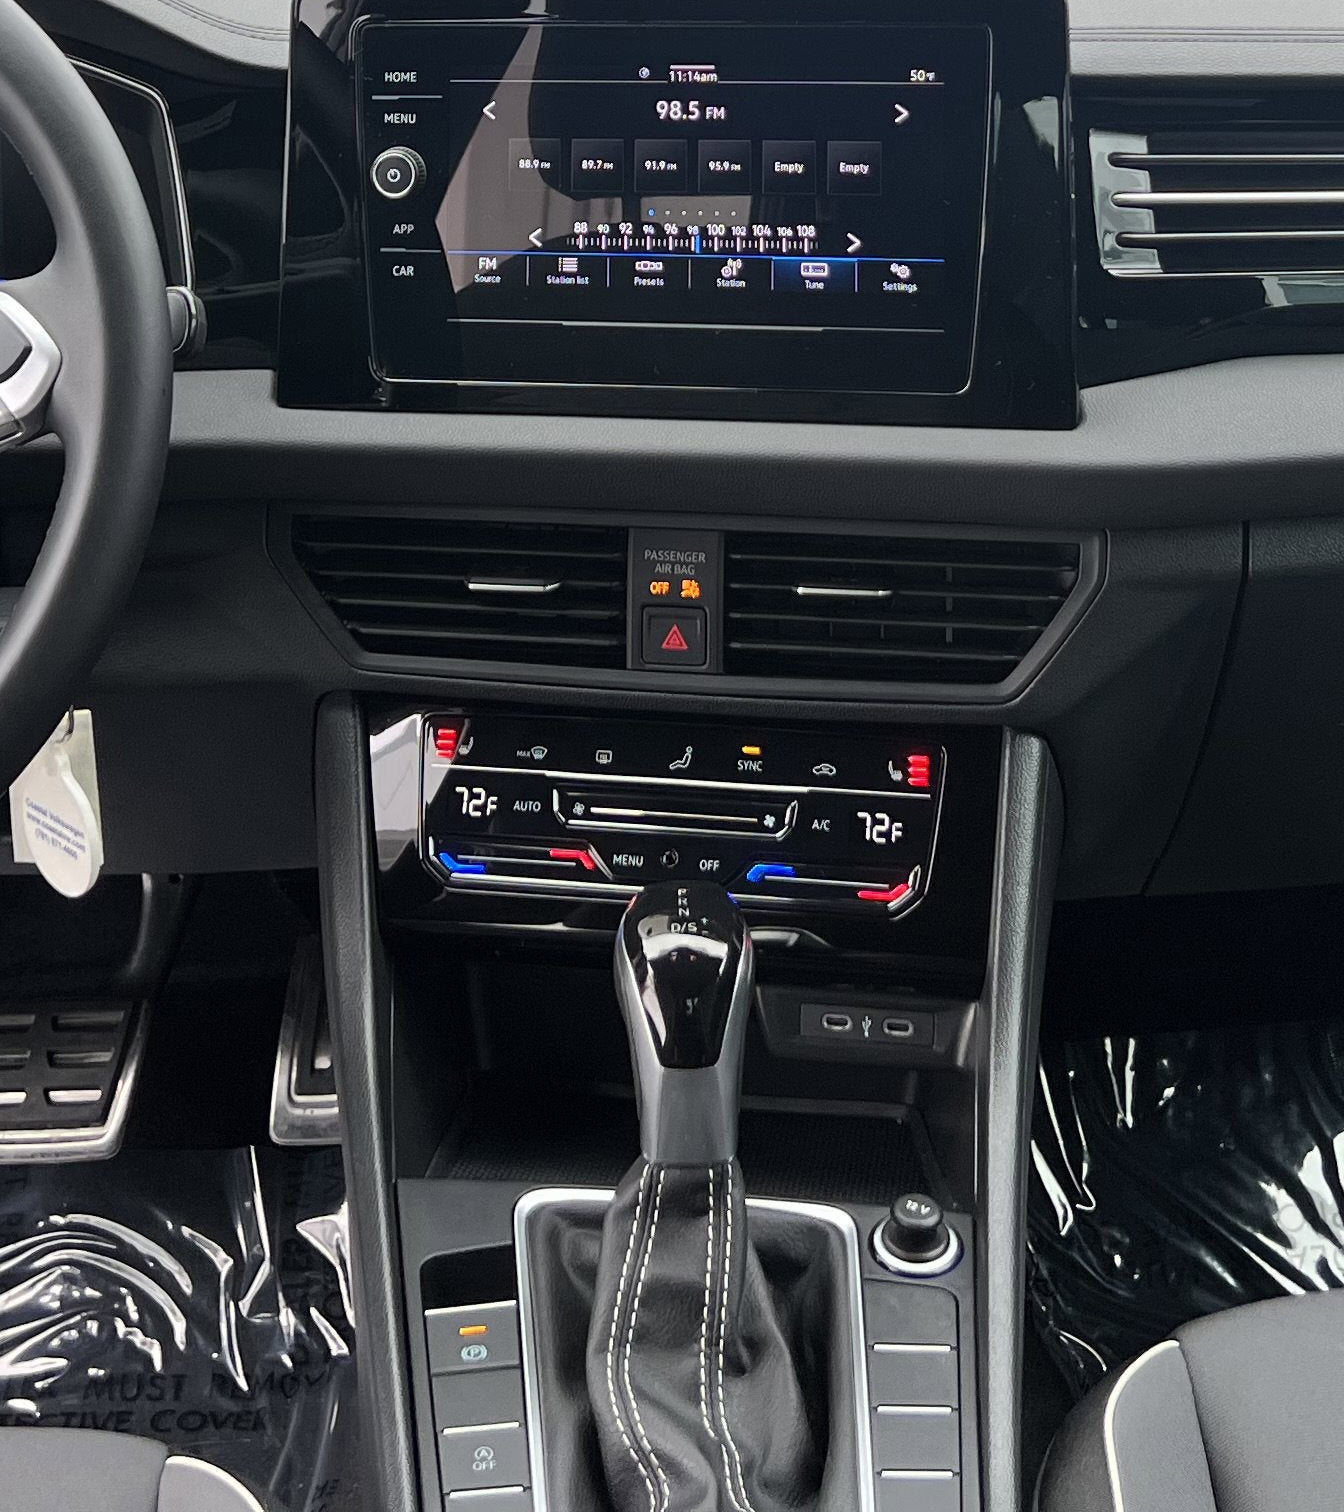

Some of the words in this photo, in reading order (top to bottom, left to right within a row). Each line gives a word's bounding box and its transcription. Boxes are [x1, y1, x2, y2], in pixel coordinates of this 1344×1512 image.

[384, 71, 418, 83] HOME
[668, 70, 719, 83] 11:14am
[656, 100, 701, 121] 98.5
[705, 106, 726, 120] FM
[384, 113, 417, 124] MENU
[518, 158, 540, 170] 88.9
[581, 159, 602, 171] 89.7
[644, 160, 666, 171] 91.9
[708, 160, 730, 172] 95.9
[774, 161, 805, 175] Empty
[839, 162, 870, 176] Empty
[392, 224, 415, 235] APP
[573, 221, 588, 234] 88
[597, 224, 610, 234] 90
[618, 222, 633, 234] 92
[663, 223, 679, 235] 96
[686, 225, 699, 235] 98
[706, 223, 726, 236] 100
[731, 225, 746, 236] 102
[752, 224, 772, 236] 104
[776, 226, 794, 237] 106
[796, 224, 817, 237] 108
[478, 257, 498, 271] FM
[392, 265, 415, 277] CAR
[474, 273, 502, 285] Source
[546, 274, 573, 285] Station
[716, 277, 746, 289] Station
[804, 279, 825, 290] Tune
[644, 549, 706, 564] PASSENGER
[654, 563, 672, 574] AIR
[674, 563, 696, 576] BAG
[649, 581, 671, 596] OFF
[737, 759, 764, 773] SYNC
[513, 800, 542, 812] AUTO
[811, 819, 831, 831] A/C
[612, 853, 645, 868] MENU
[699, 858, 721, 872] OFF
[677, 888, 688, 897] P
[677, 897, 688, 907] R
[678, 907, 690, 917] N
[670, 921, 698, 934] D/S
[80, 1372, 185, 1402] MUST
[472, 1460, 497, 1471] OFF
